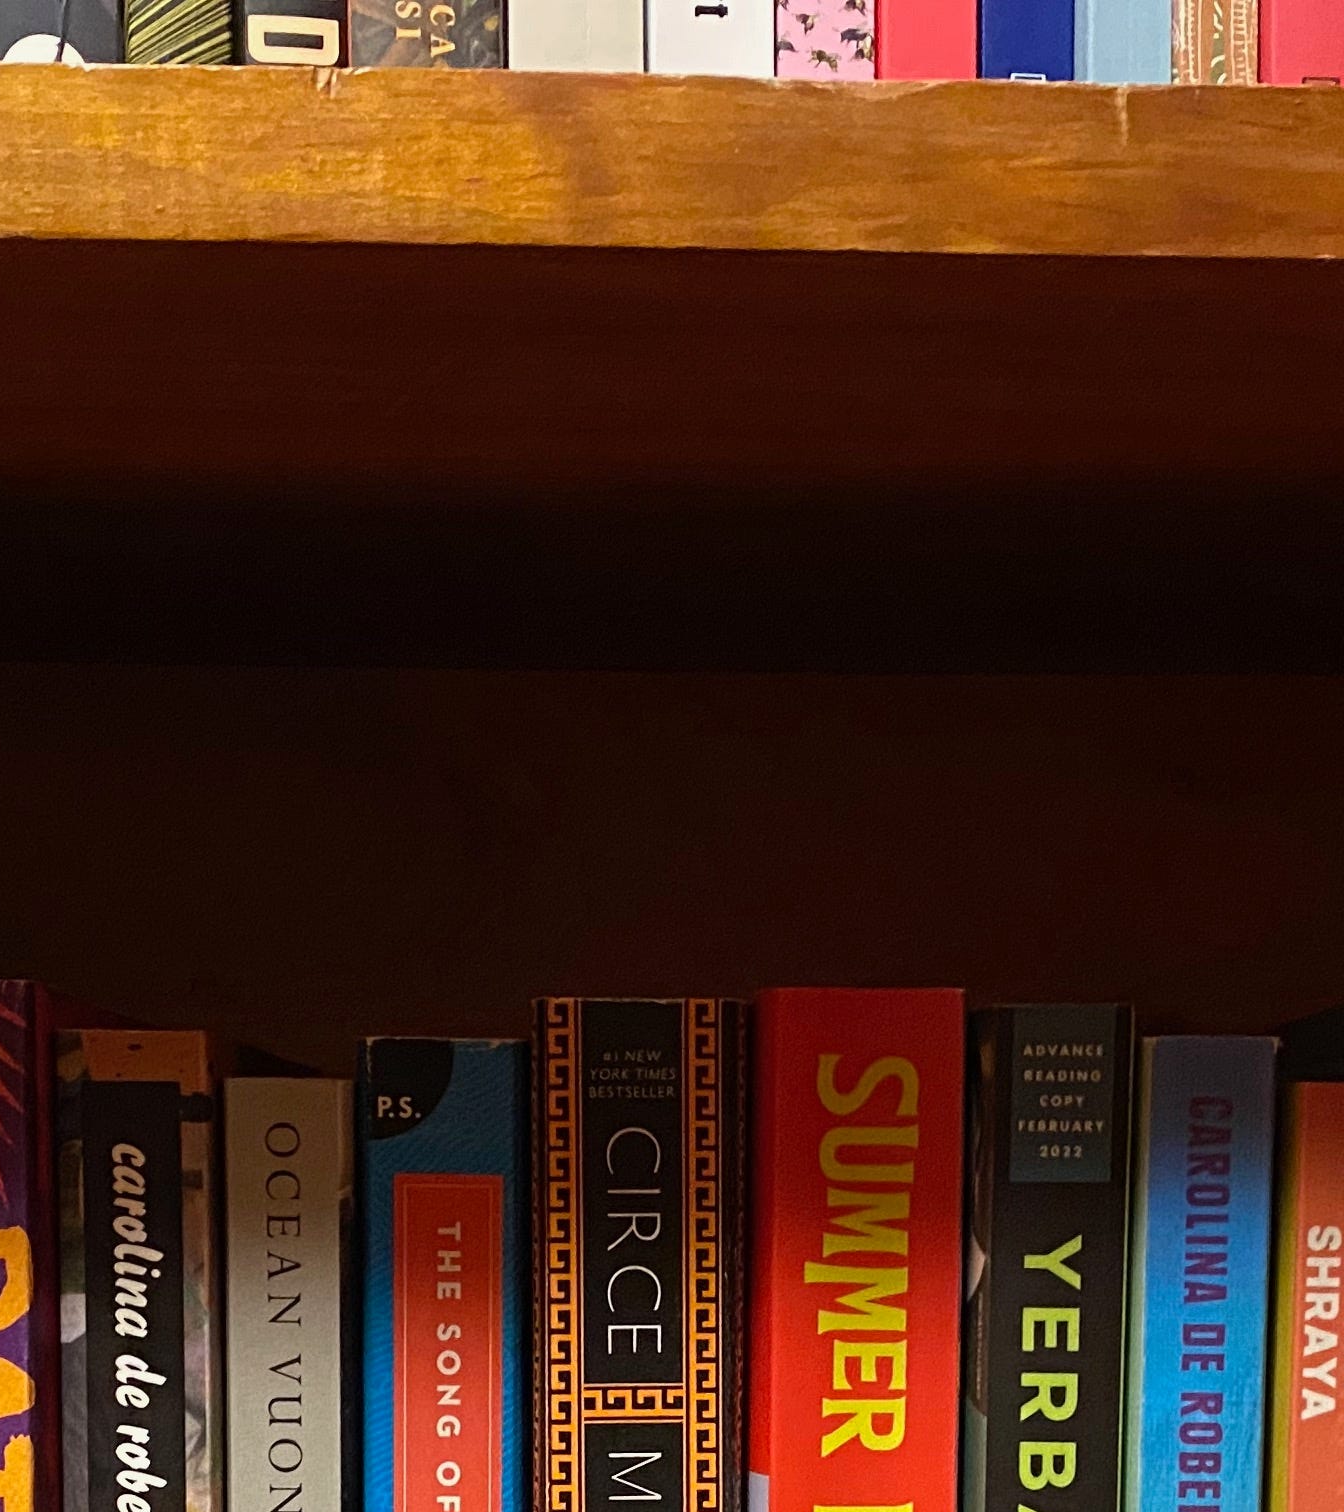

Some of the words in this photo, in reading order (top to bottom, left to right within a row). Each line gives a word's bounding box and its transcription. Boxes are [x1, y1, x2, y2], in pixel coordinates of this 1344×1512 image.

[590, 1066, 631, 1081] YORK
[1022, 1044, 1105, 1058] ADVANCE
[1023, 1069, 1103, 1083] READING
[376, 1095, 422, 1120] P.S.
[588, 1085, 675, 1099] BESTSELLER
[1039, 1094, 1085, 1108] COPY
[1017, 1119, 1105, 1134] FEBRUARY
[263, 1120, 305, 1329] OCEAN
[1182, 1094, 1233, 1306] CAROLINA
[111, 1141, 164, 1339] carolina
[435, 1221, 462, 1301] THE
[605, 1126, 662, 1355] CIRCE
[803, 1053, 920, 1458] SUMMER
[1179, 1322, 1226, 1373] DE
[1301, 1225, 1343, 1421] SHRAYA
[114, 1354, 168, 1410] de
[435, 1323, 462, 1439] SONG
